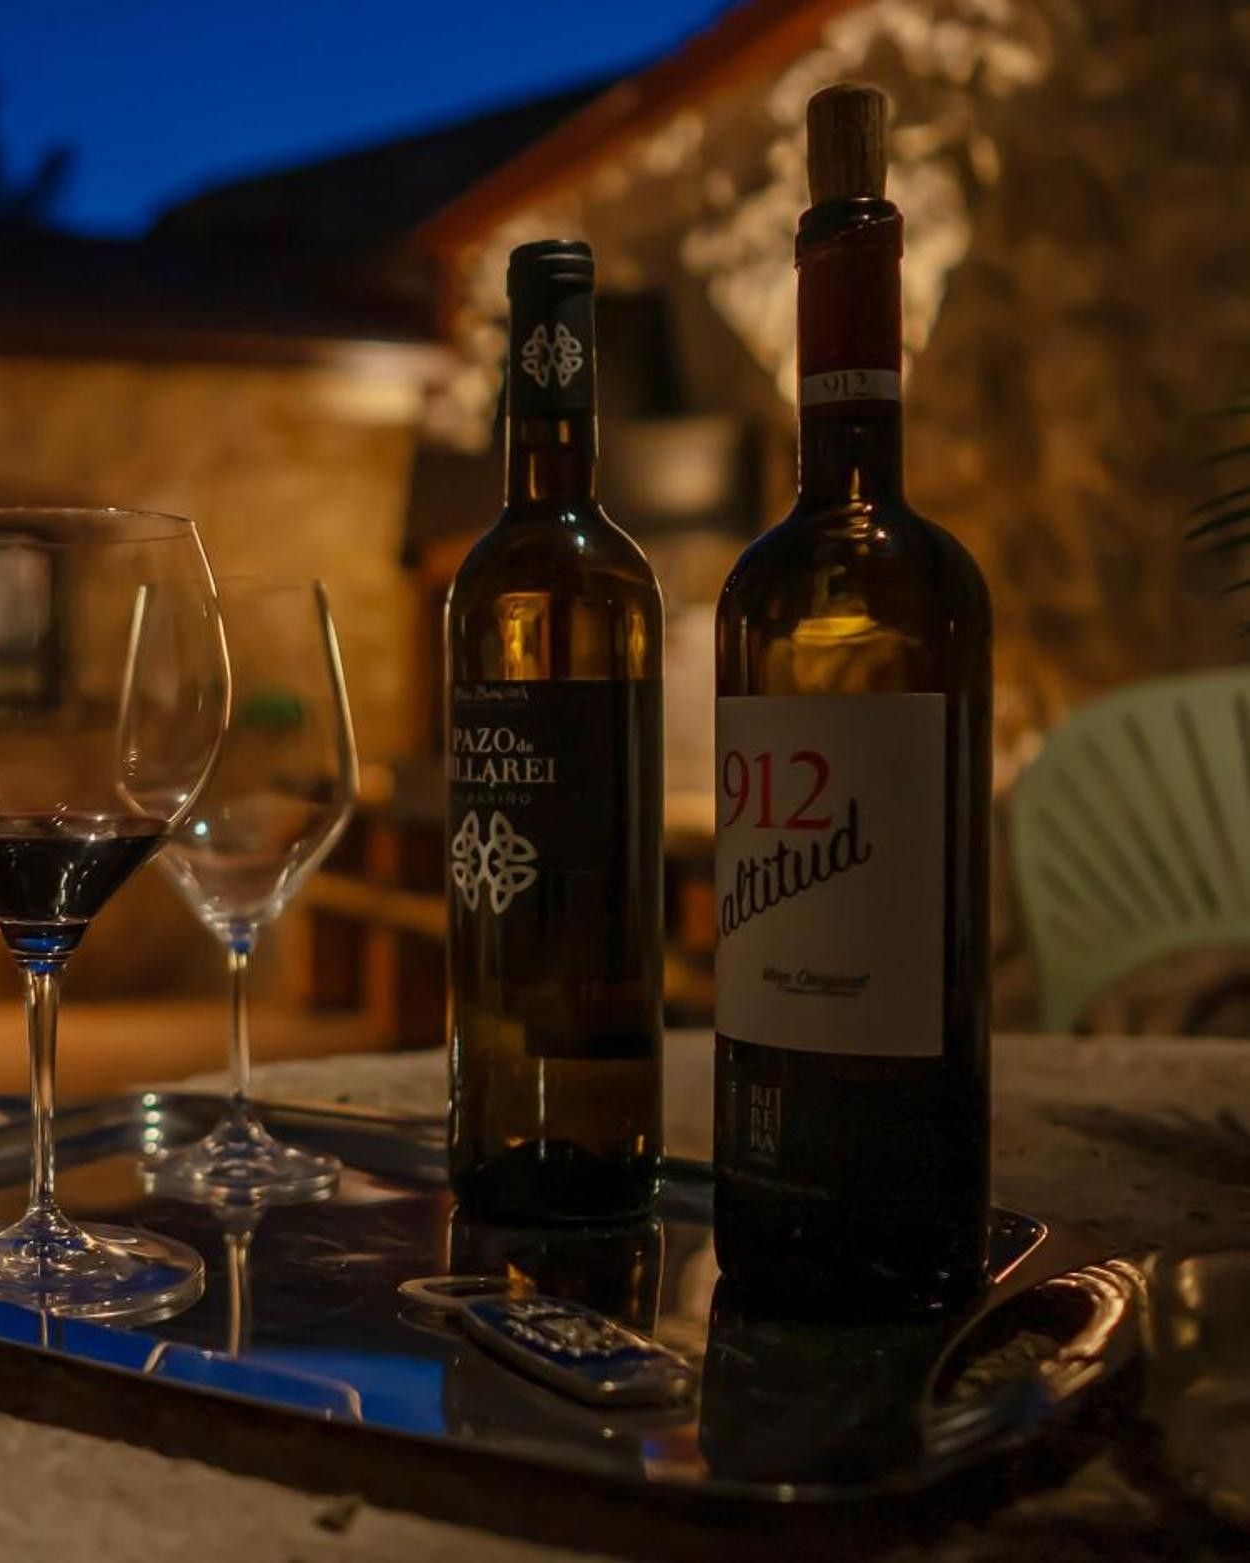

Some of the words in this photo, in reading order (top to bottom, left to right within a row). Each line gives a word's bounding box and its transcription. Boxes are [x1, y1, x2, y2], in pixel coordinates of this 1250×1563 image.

[822, 371, 868, 396] 912
[453, 727, 517, 753] PAZO
[723, 750, 832, 829] 912
[722, 797, 872, 937] altitud
